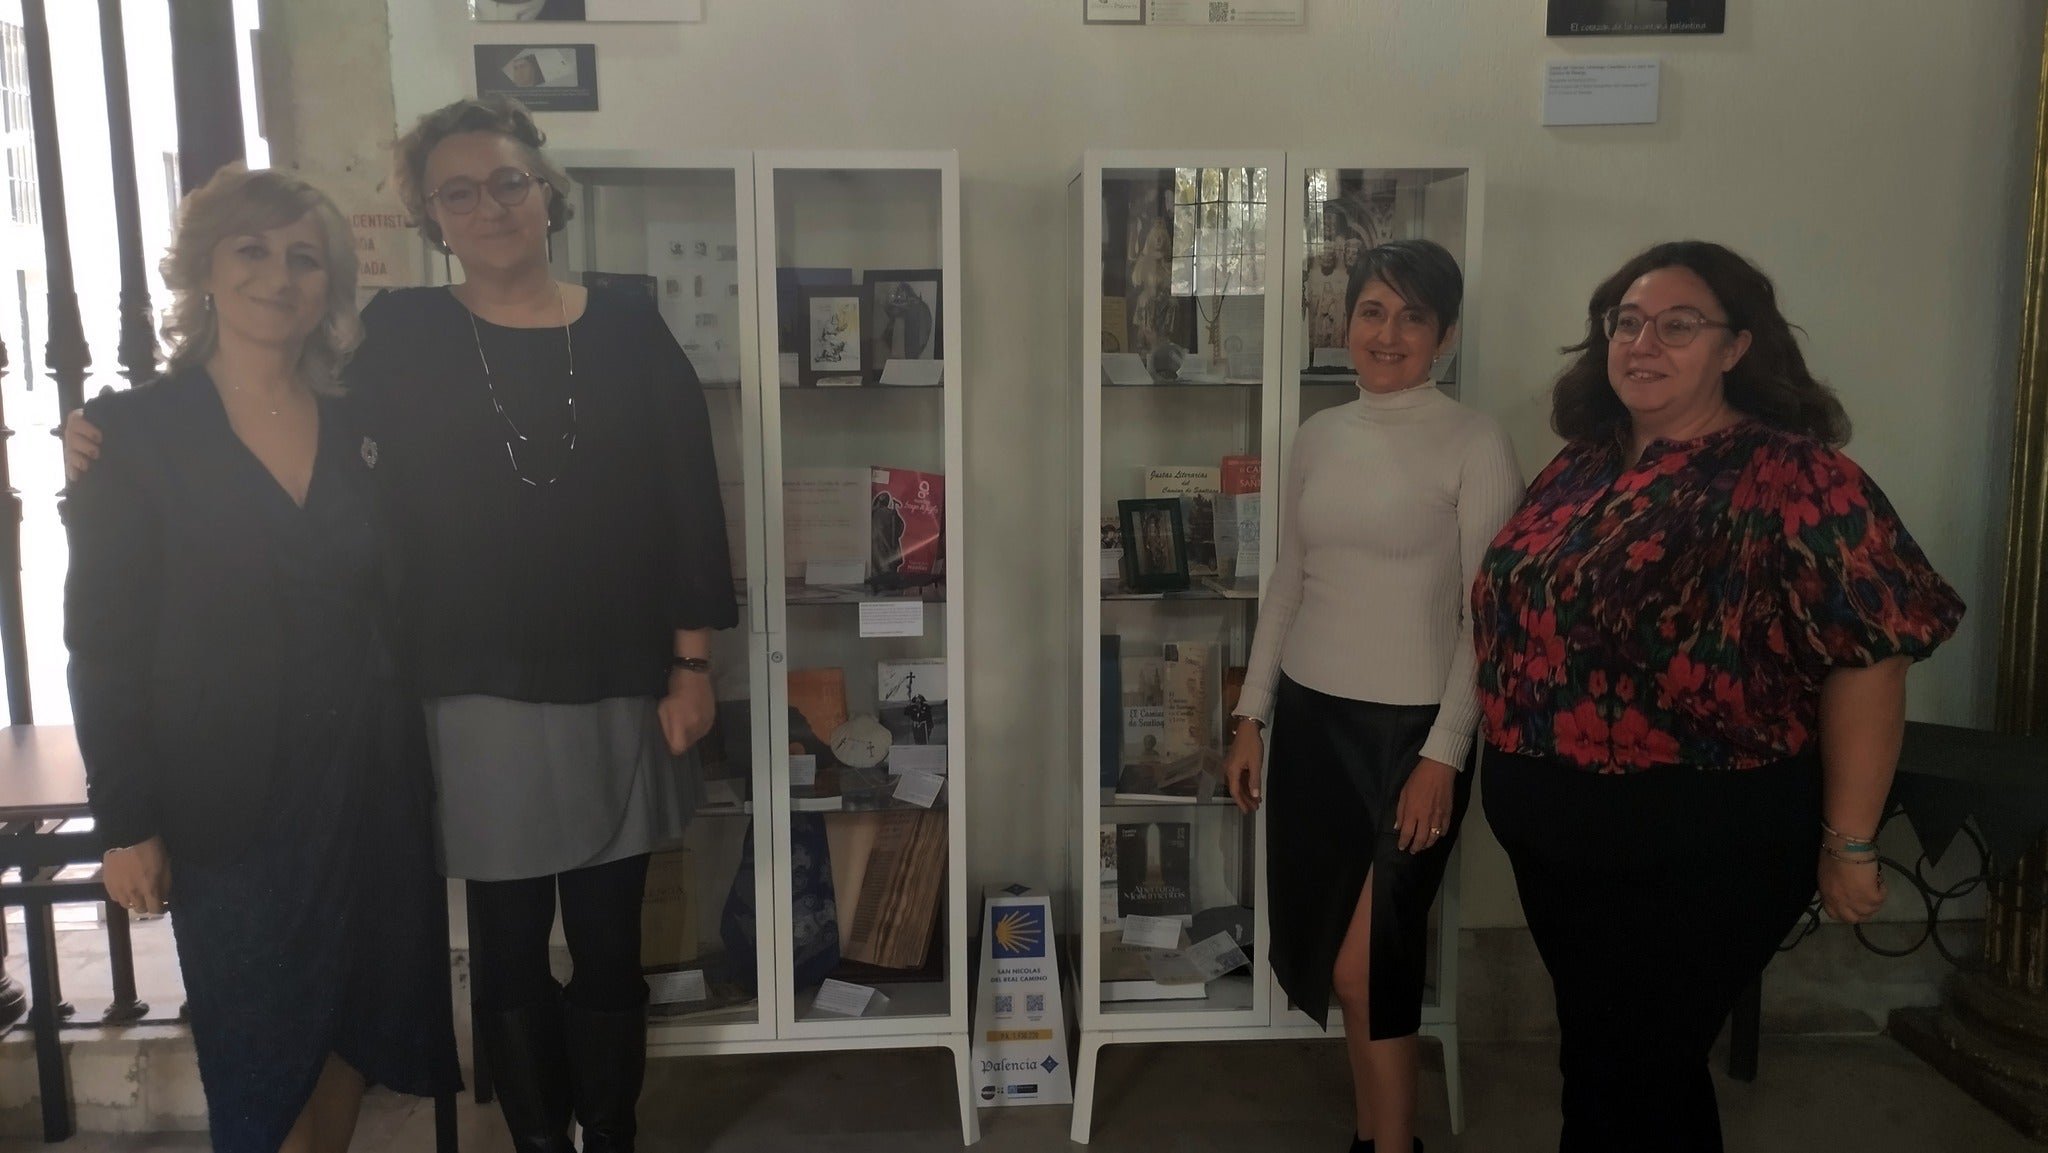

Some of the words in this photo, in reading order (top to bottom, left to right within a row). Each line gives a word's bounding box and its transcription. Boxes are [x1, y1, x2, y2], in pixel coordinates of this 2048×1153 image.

[1174, 470, 1208, 479] Literarias
[1138, 718, 1165, 729] Santiag
[980, 1058, 1038, 1073] Palencia
